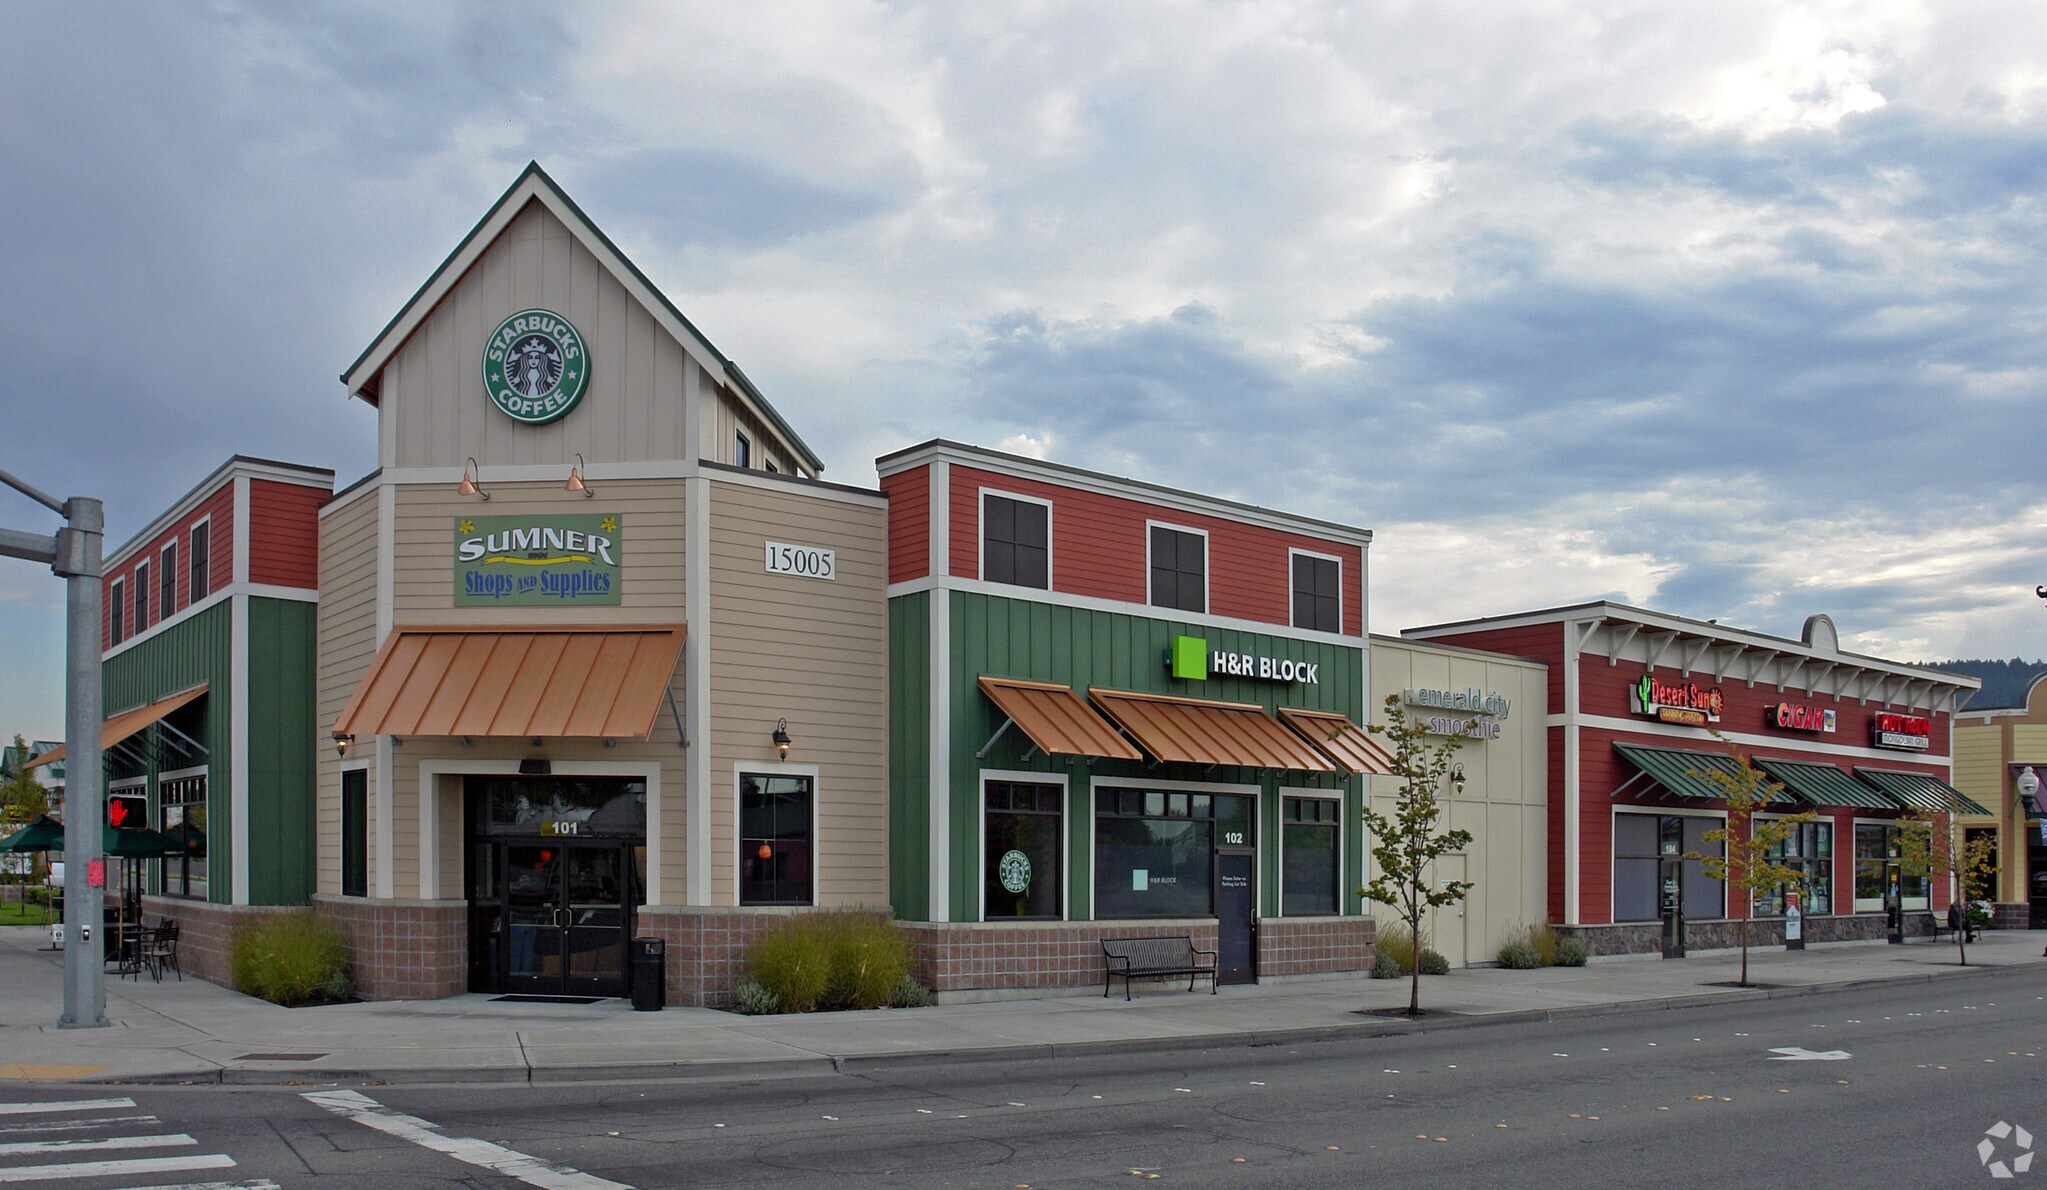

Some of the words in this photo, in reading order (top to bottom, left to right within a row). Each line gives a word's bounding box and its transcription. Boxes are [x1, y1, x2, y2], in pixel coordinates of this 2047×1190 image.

[489, 316, 579, 362] STARBUCKS
[499, 389, 567, 415] COFFEE
[458, 527, 618, 567] SUMNER
[769, 546, 831, 576] 15005
[465, 570, 513, 599] Shops
[540, 569, 610, 599] Supplies
[1213, 650, 1254, 677] H&R
[1259, 656, 1319, 685] BLOCK
[1419, 687, 1481, 712] emerald
[1485, 691, 1512, 719] city
[1651, 677, 1688, 706] Desert
[1690, 683, 1711, 709] Sun
[1777, 702, 1824, 731] CIGAR
[551, 821, 578, 834] 101
[1225, 832, 1243, 844] 102
[1002, 852, 1029, 871] STARBUCKS
[1004, 879, 1026, 891] COFFEE
